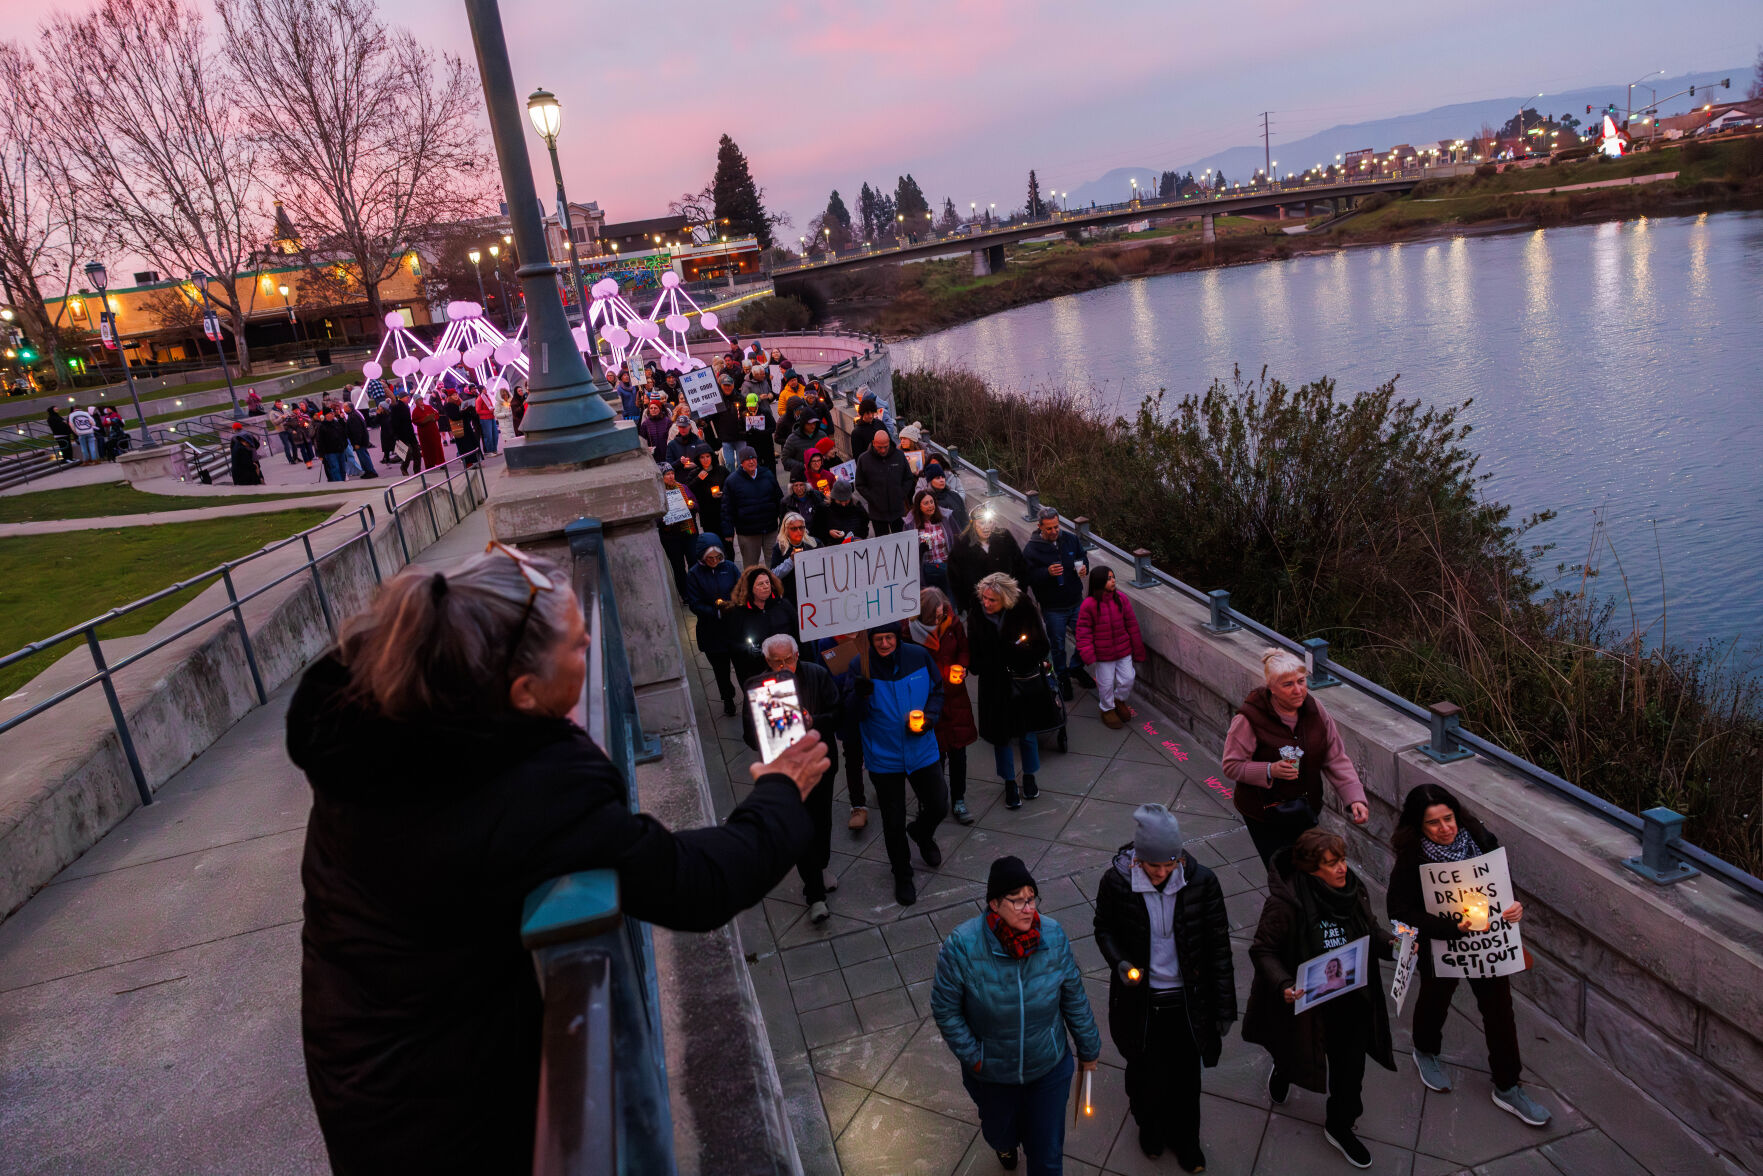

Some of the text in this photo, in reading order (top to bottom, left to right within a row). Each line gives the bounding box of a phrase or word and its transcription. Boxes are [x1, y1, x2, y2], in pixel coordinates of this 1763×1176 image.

[802, 541, 910, 598] HUMAN
[800, 579, 917, 631] RIGHTS
[1441, 953, 1479, 968] GET
